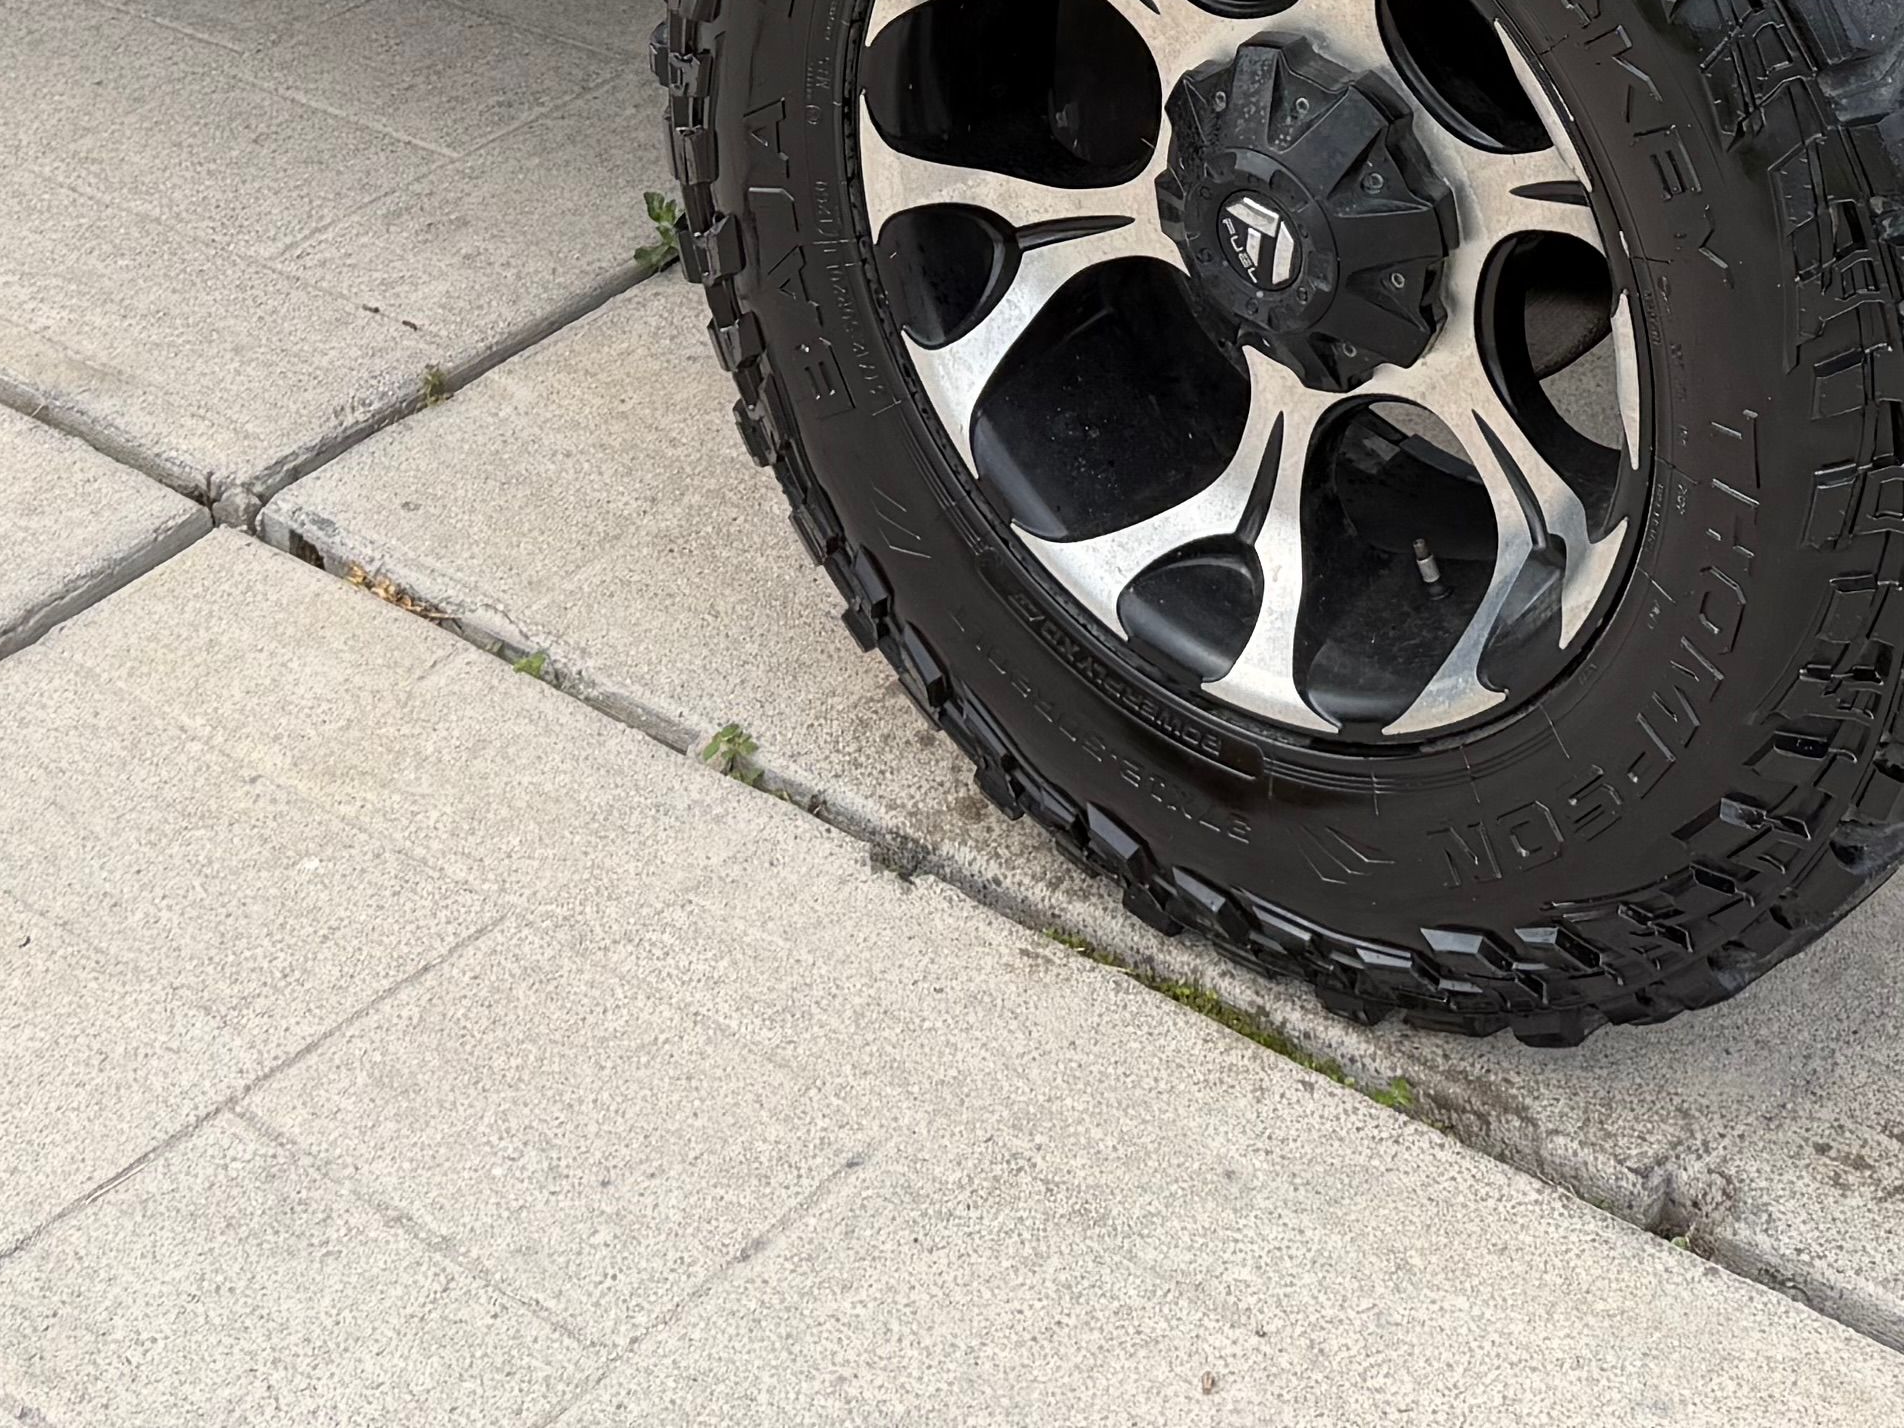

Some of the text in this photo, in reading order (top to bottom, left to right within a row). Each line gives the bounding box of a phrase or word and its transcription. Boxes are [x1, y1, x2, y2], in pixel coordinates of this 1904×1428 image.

[742, 96, 857, 416] BAJA
[1222, 217, 1258, 284] FUEL
[1426, 408, 1760, 886] THOMPSON
